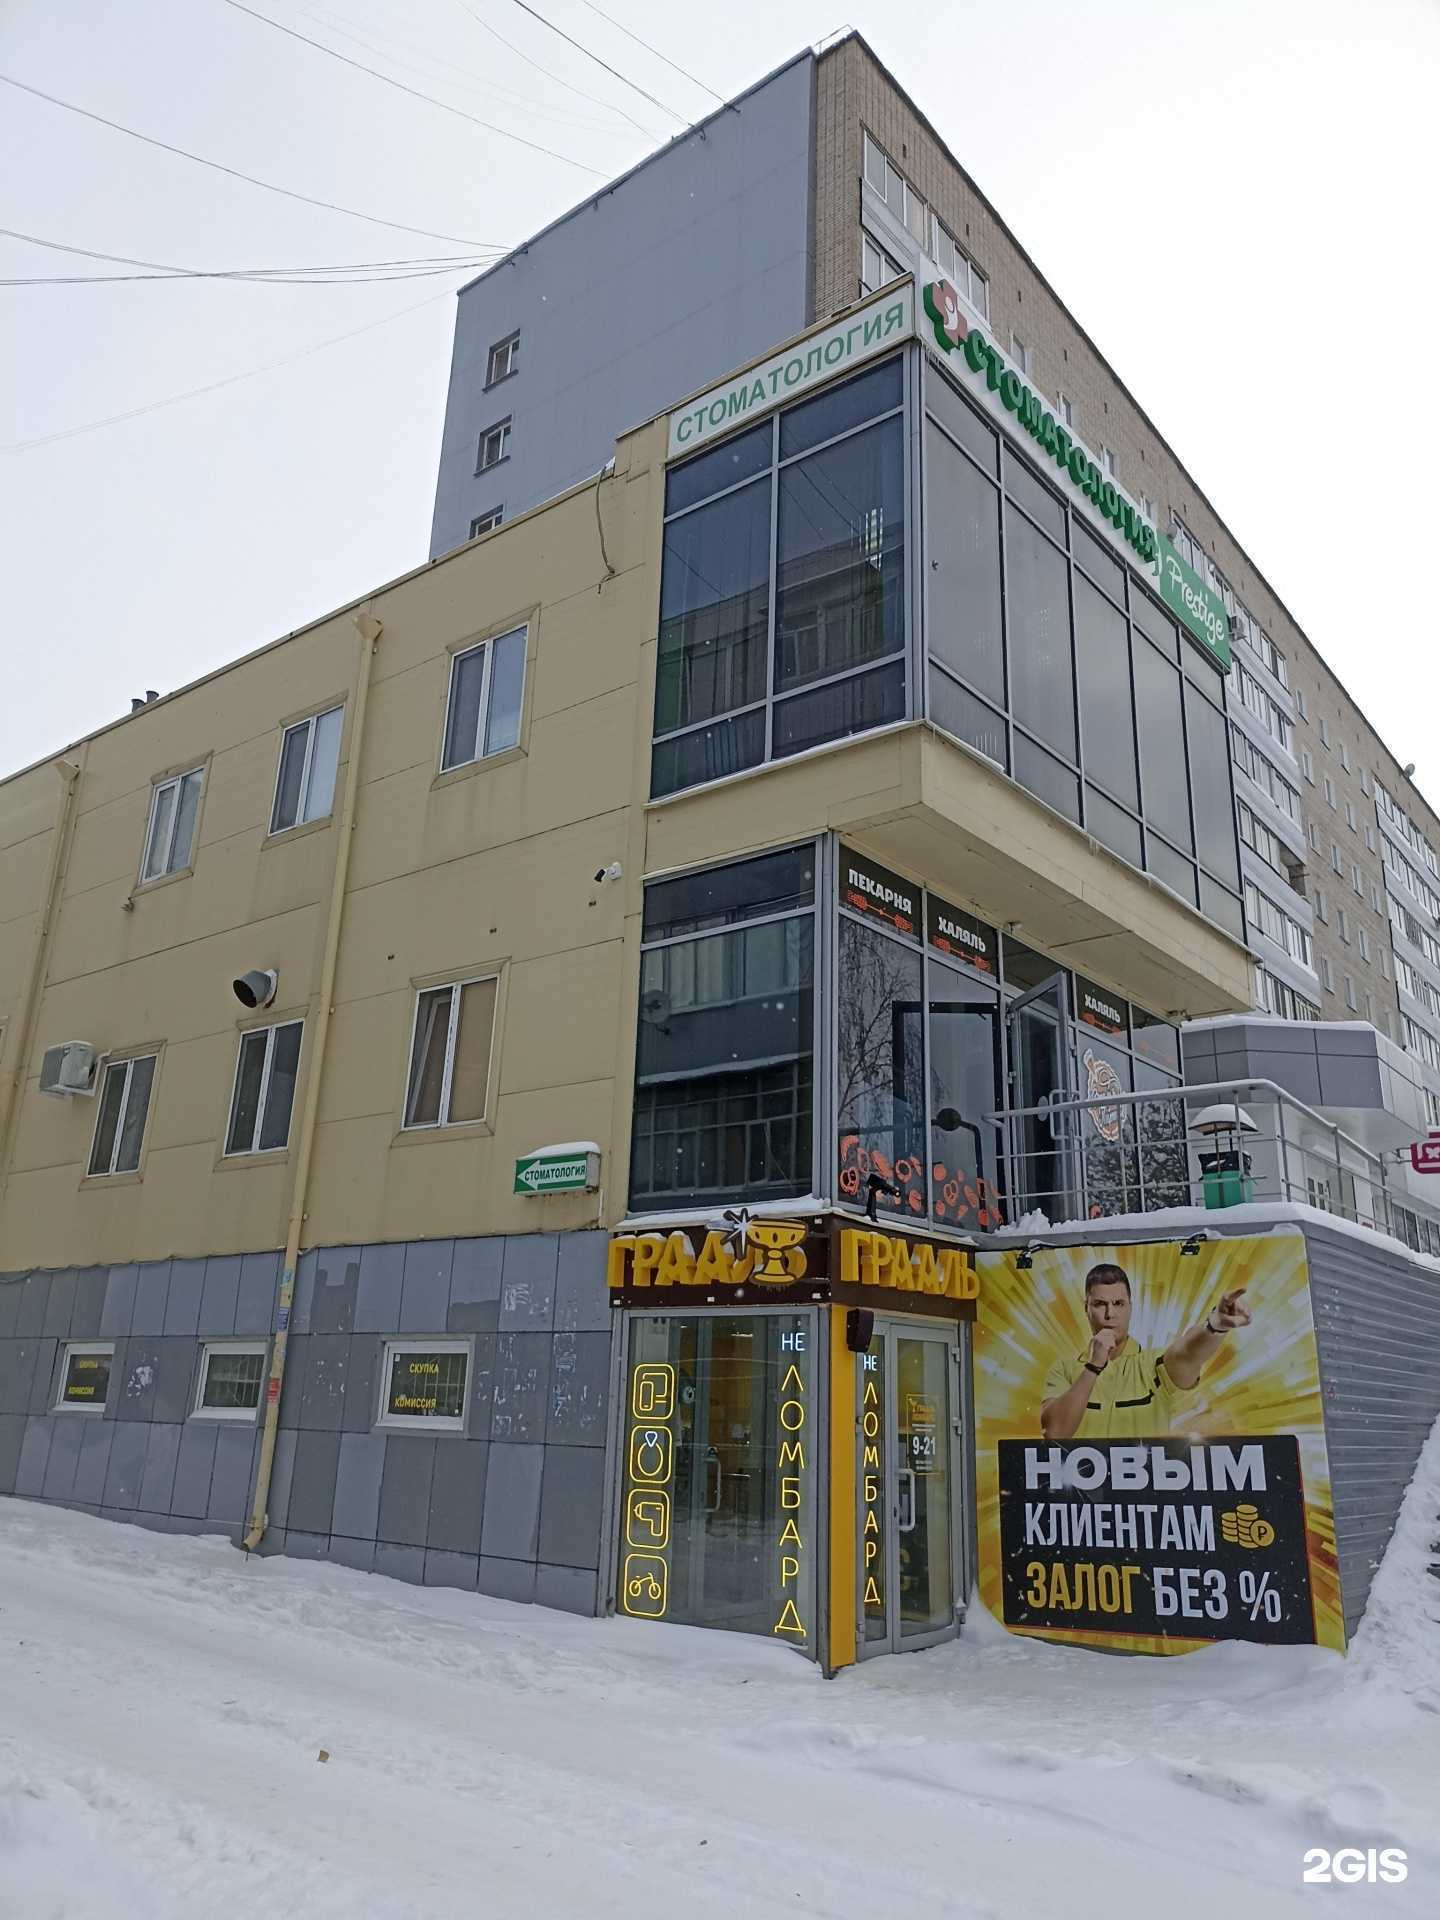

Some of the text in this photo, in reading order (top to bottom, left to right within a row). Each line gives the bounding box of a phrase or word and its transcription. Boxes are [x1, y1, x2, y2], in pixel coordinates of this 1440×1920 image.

[676, 302, 904, 442] СТОМАТОЛОГИЯ
[965, 327, 1163, 577] СТОМАТОЛОГИЯ
[1166, 555, 1225, 646] Prestige
[848, 868, 912, 914] ПЕКАРНЯ
[938, 916, 986, 952] ХАЛЯЛЬ
[1084, 993, 1121, 1023] ХАЛЯЛЬ
[524, 1165, 586, 1181] СТОМАТОЛОГИЯ
[840, 1228, 980, 1300] ГРААЛЬ
[409, 1363, 439, 1374] СКУПКА
[394, 1397, 437, 1409] КОМИССИЯ
[912, 1435, 936, 1455] 9-21
[1024, 1444, 1266, 1492] НОВЫМ
[774, 1332, 806, 1637] НЕ ЛОМБАРД
[862, 1354, 881, 1605] НЕ ЛОМБАРД
[1024, 1502, 1216, 1552] КЛИЕНТАМ
[1026, 1561, 1282, 1623] ЗАЛОГ БЕЗ %
